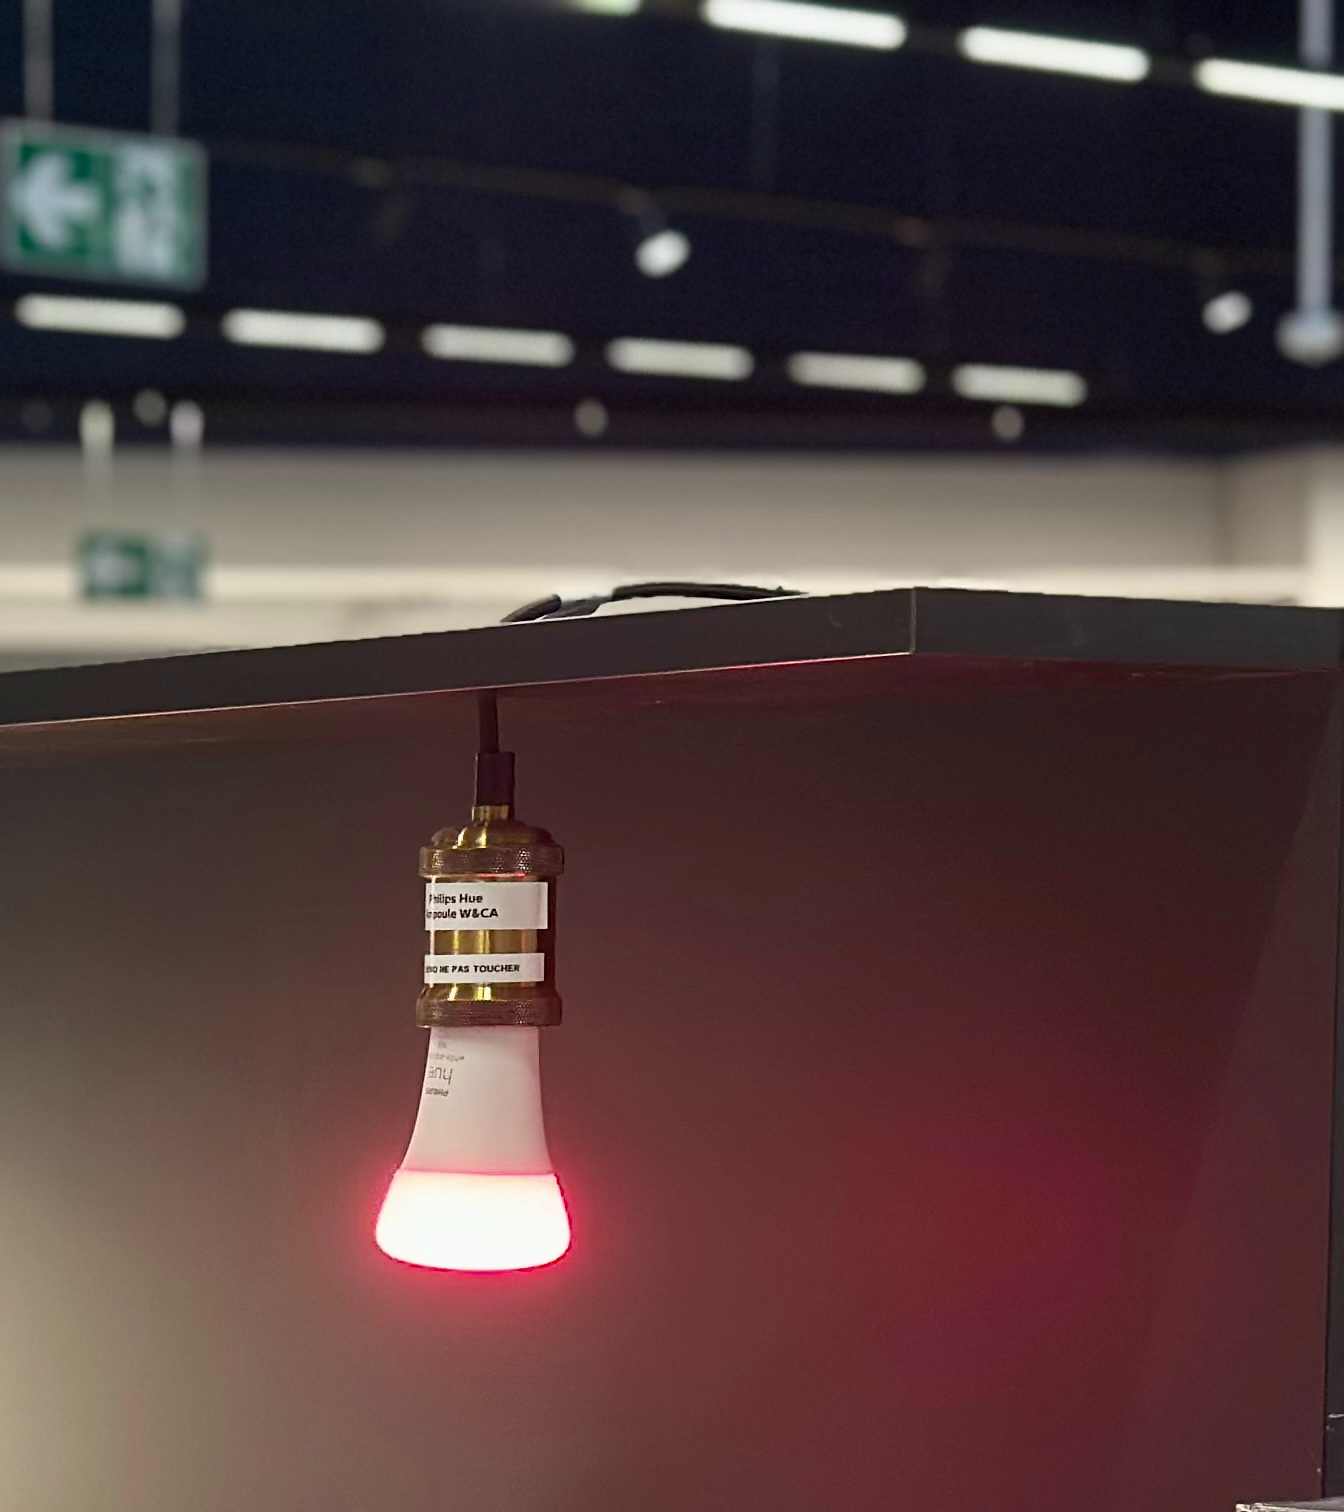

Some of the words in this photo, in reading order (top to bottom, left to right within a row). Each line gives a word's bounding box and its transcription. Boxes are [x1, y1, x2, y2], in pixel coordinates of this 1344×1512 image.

[459, 893, 483, 904] Hue
[459, 908, 499, 919] W&CA
[451, 965, 470, 973] PAS
[473, 964, 520, 973] TOUCHER
